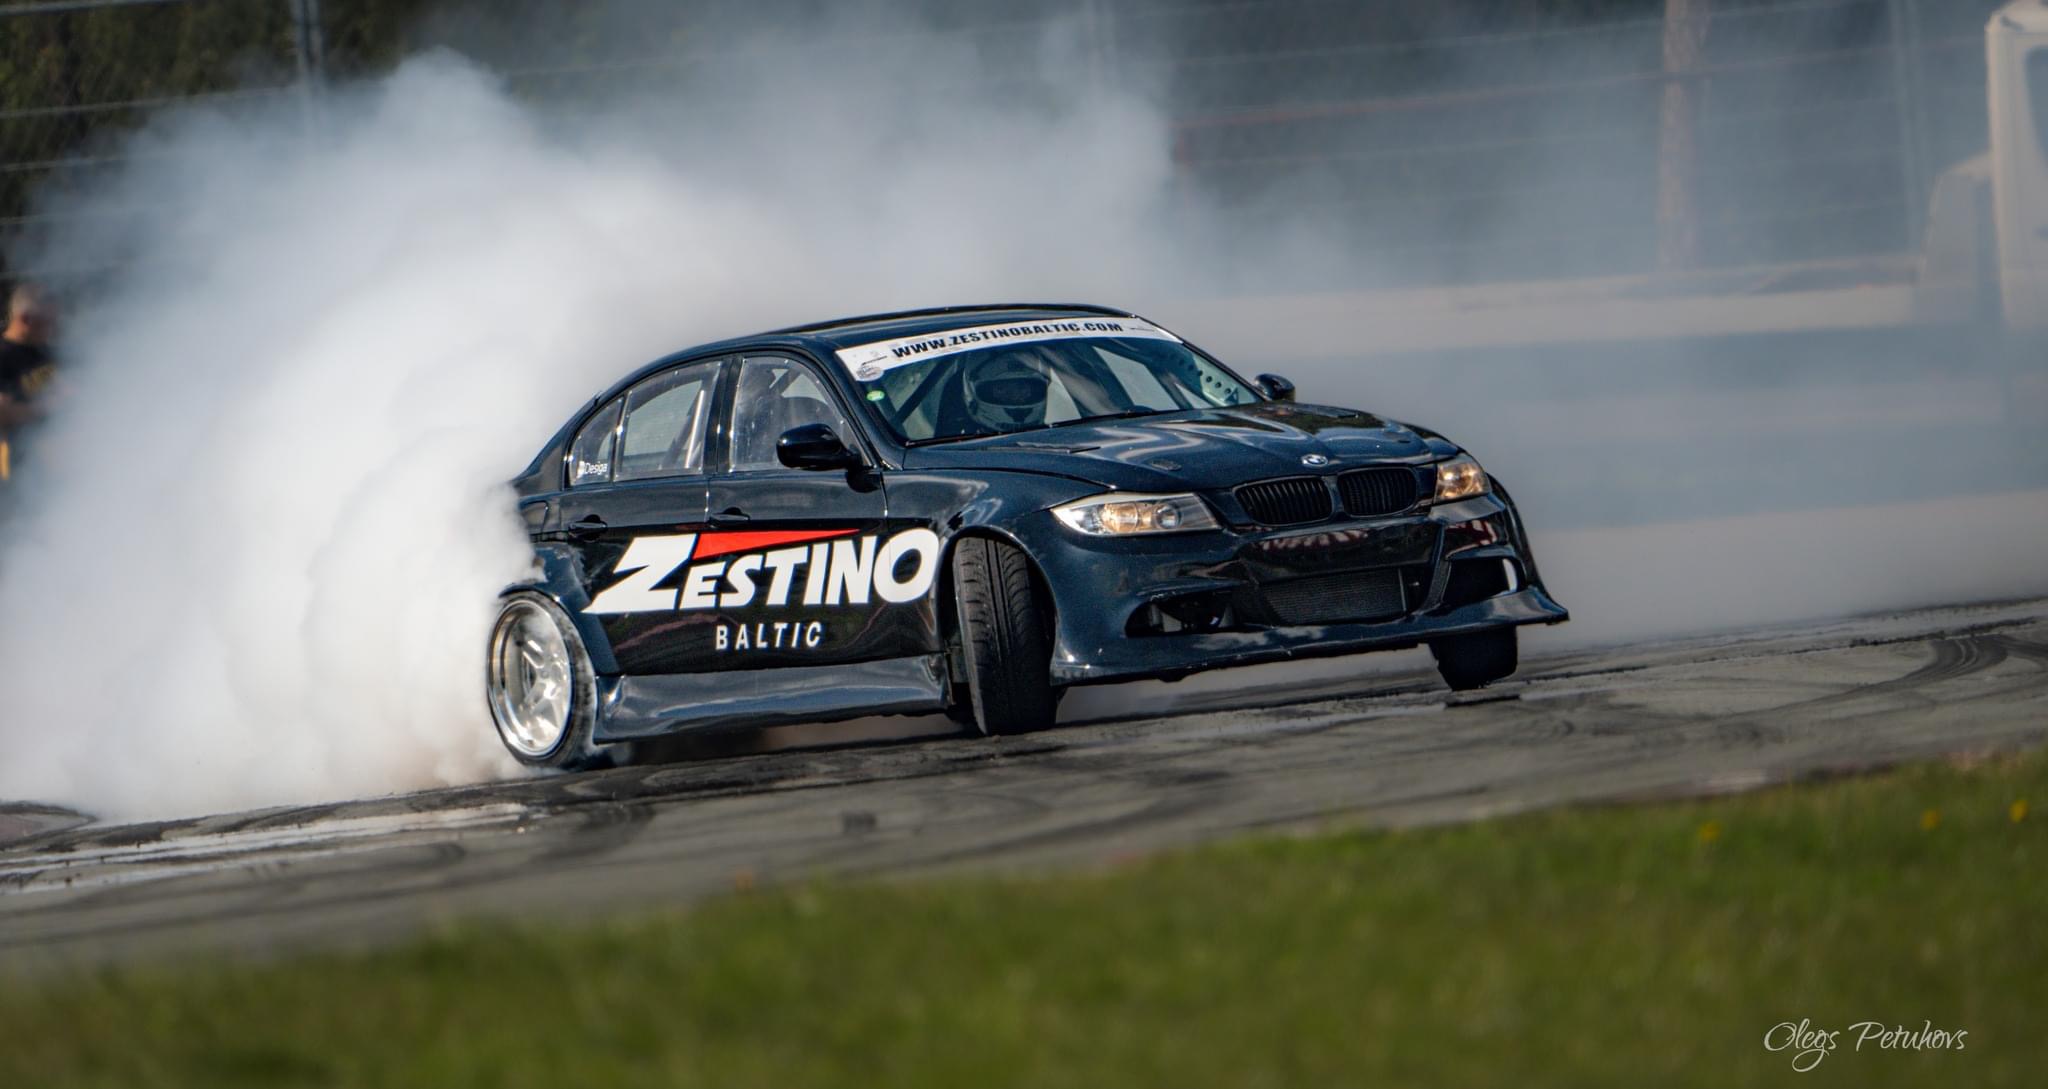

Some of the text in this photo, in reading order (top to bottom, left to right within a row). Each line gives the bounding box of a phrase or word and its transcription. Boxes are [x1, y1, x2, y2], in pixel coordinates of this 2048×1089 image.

[892, 322, 1123, 358] WWW.ZESTINOBALTIC.COM
[580, 528, 940, 613] ZESTINO
[715, 621, 822, 650] BALTIC
